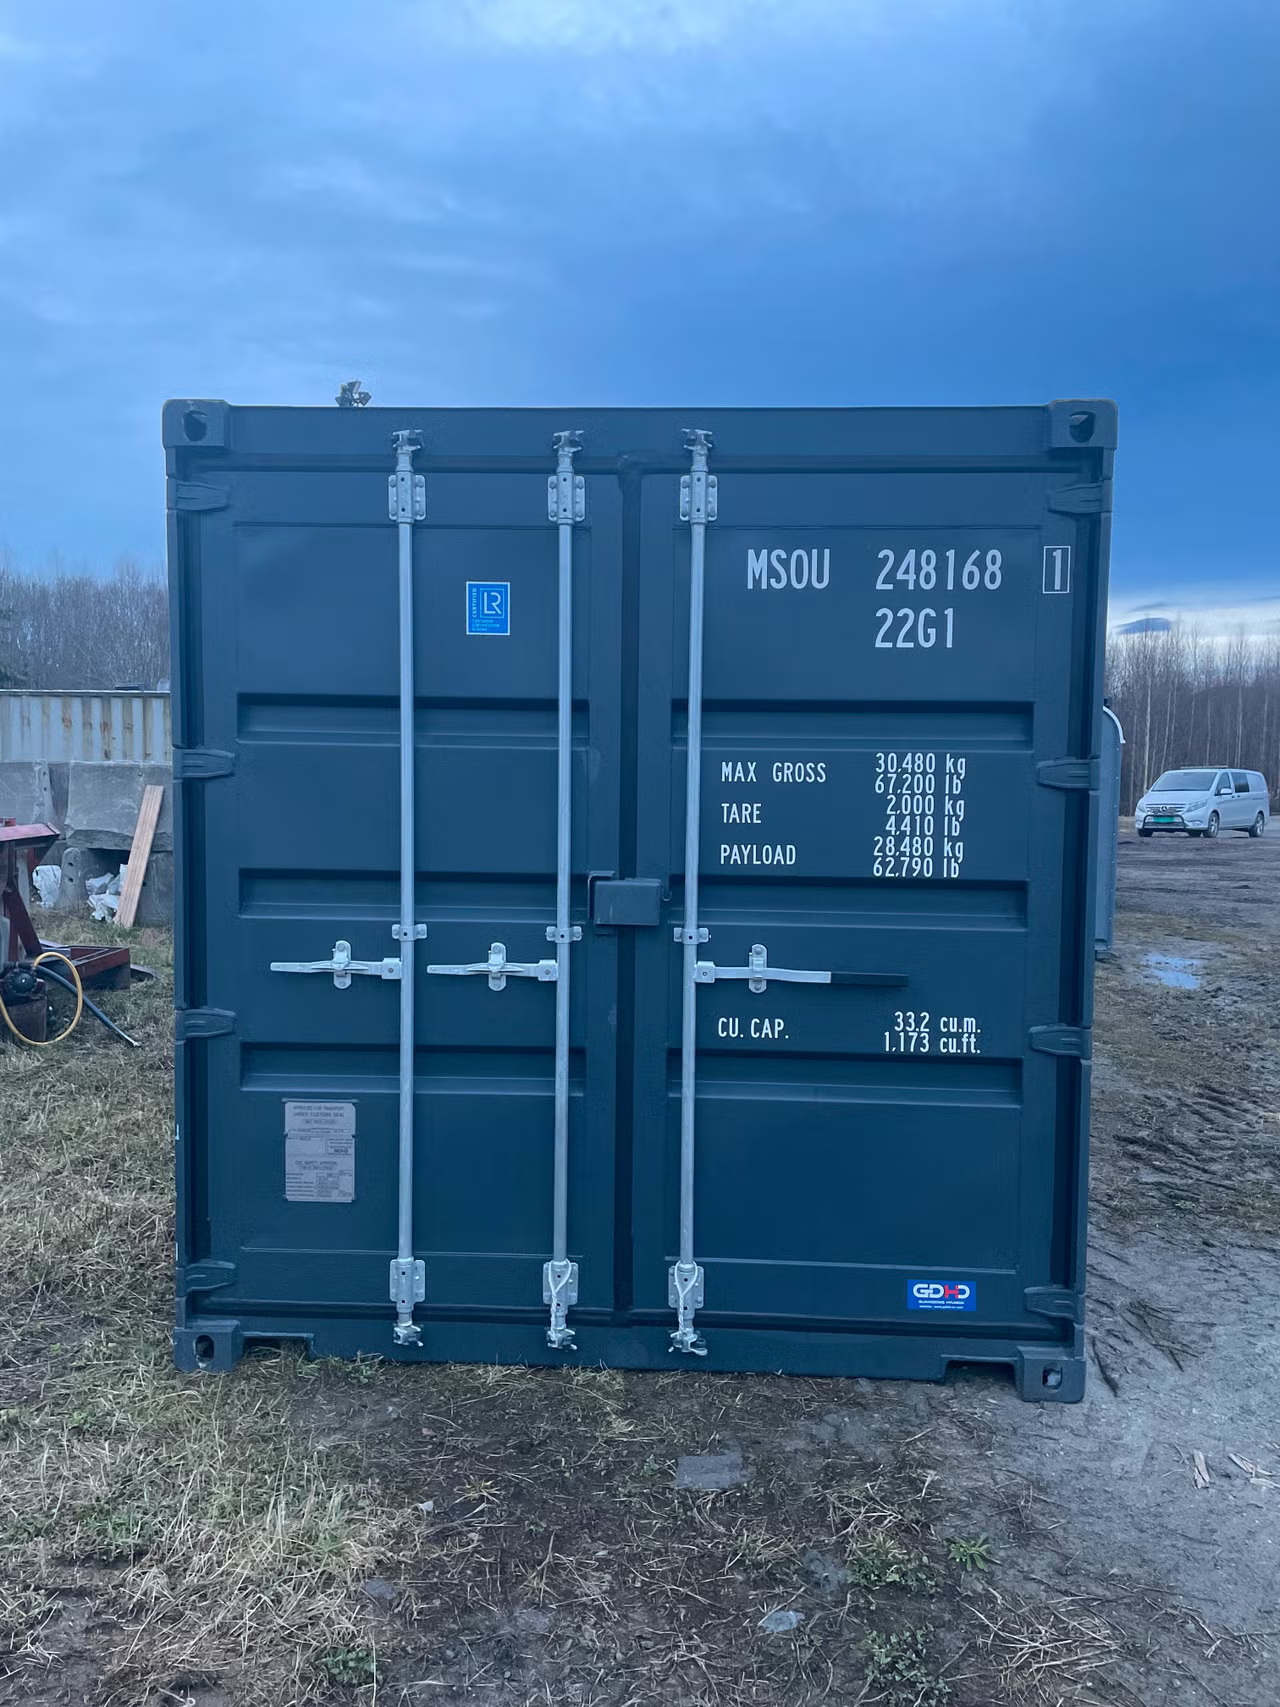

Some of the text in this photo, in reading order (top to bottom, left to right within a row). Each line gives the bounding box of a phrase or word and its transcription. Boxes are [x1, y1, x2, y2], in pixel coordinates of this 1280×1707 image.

[747, 549, 1062, 590] MSOU 248168 1
[875, 607, 954, 648] 22G1
[721, 761, 827, 783] MAX GROSS
[875, 753, 966, 780] 30,480 kg
[875, 773, 962, 794] 67,200 lb
[721, 803, 762, 824] TARE
[886, 794, 965, 822] 2,000 kg
[885, 815, 961, 836] 4,410 lb
[720, 844, 796, 865] PAYLOAD
[873, 836, 964, 864] 28,480 kg
[873, 857, 960, 878] 62,790 lb
[718, 1017, 789, 1039] CU. CAP.
[894, 1011, 982, 1033] 33.2 cu.m.
[884, 1031, 981, 1054] 1,173 cu.ft.
[913, 1284, 970, 1299] GDHD
